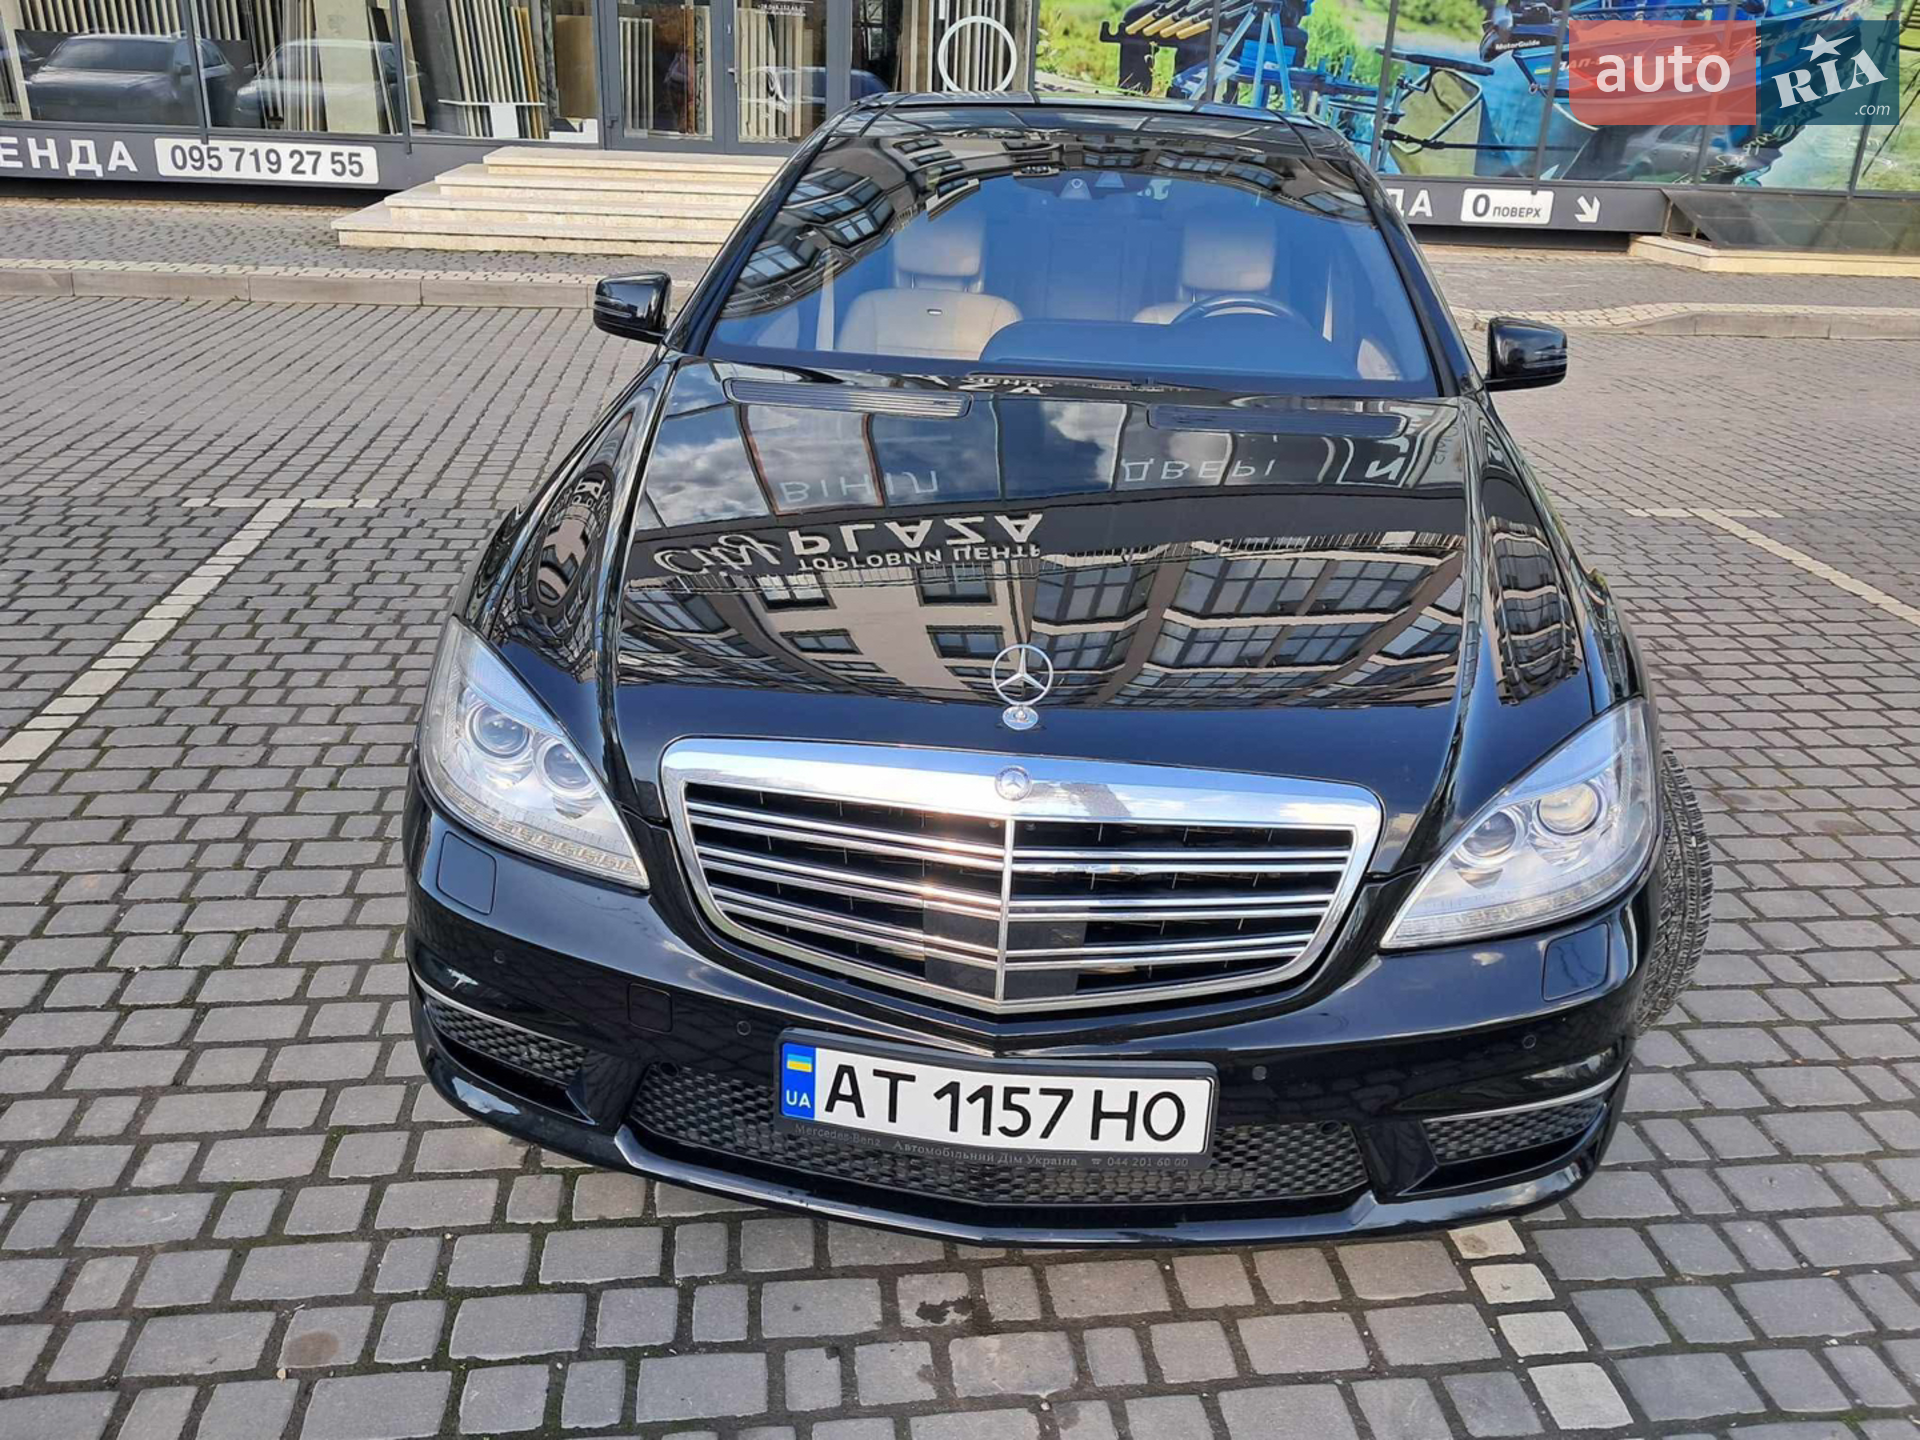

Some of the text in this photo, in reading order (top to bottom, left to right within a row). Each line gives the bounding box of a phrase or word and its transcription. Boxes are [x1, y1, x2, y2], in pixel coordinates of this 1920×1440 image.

[1495, 39, 1541, 51] MotorGuide
[170, 144, 364, 177] 095 719 27 55
[1472, 193, 1542, 218] 0 ПОВЕРХ
[786, 1089, 811, 1108] UA
[824, 1064, 1187, 1142] AT 1157 HO
[892, 1140, 996, 1163] Автомобільний
[1107, 1157, 1129, 1167] 044
